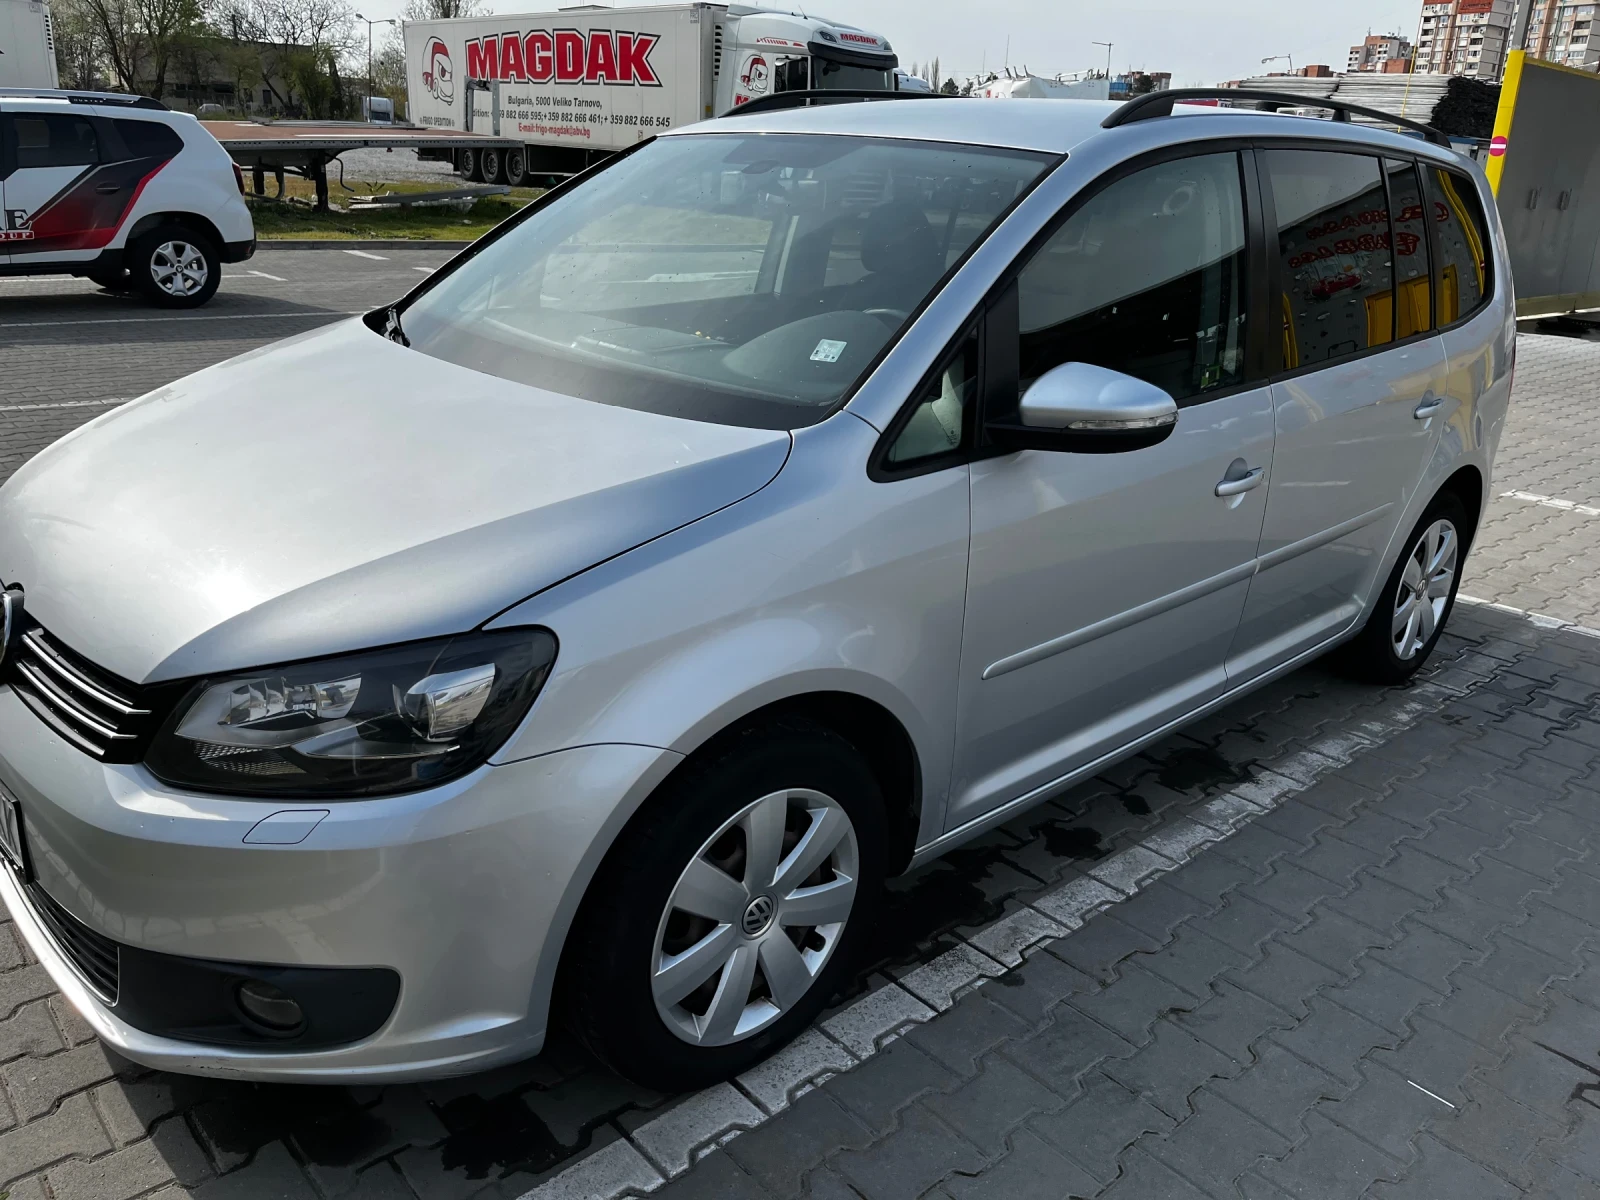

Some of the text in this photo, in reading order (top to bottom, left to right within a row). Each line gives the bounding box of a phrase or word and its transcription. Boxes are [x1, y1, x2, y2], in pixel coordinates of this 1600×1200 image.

[840, 33, 878, 45] MAGDAK
[465, 28, 663, 88] MAGDAK
[508, 96, 602, 110] Bulgaria, 5000 Veliko Tarnovo,
[506, 110, 517, 119] 882
[518, 111, 529, 120] 666
[561, 112, 573, 122] 882
[574, 113, 587, 123] 666
[610, 114, 623, 124] 359
[624, 115, 638, 126] 882
[640, 116, 654, 127] 666
[656, 117, 671, 128] 545
